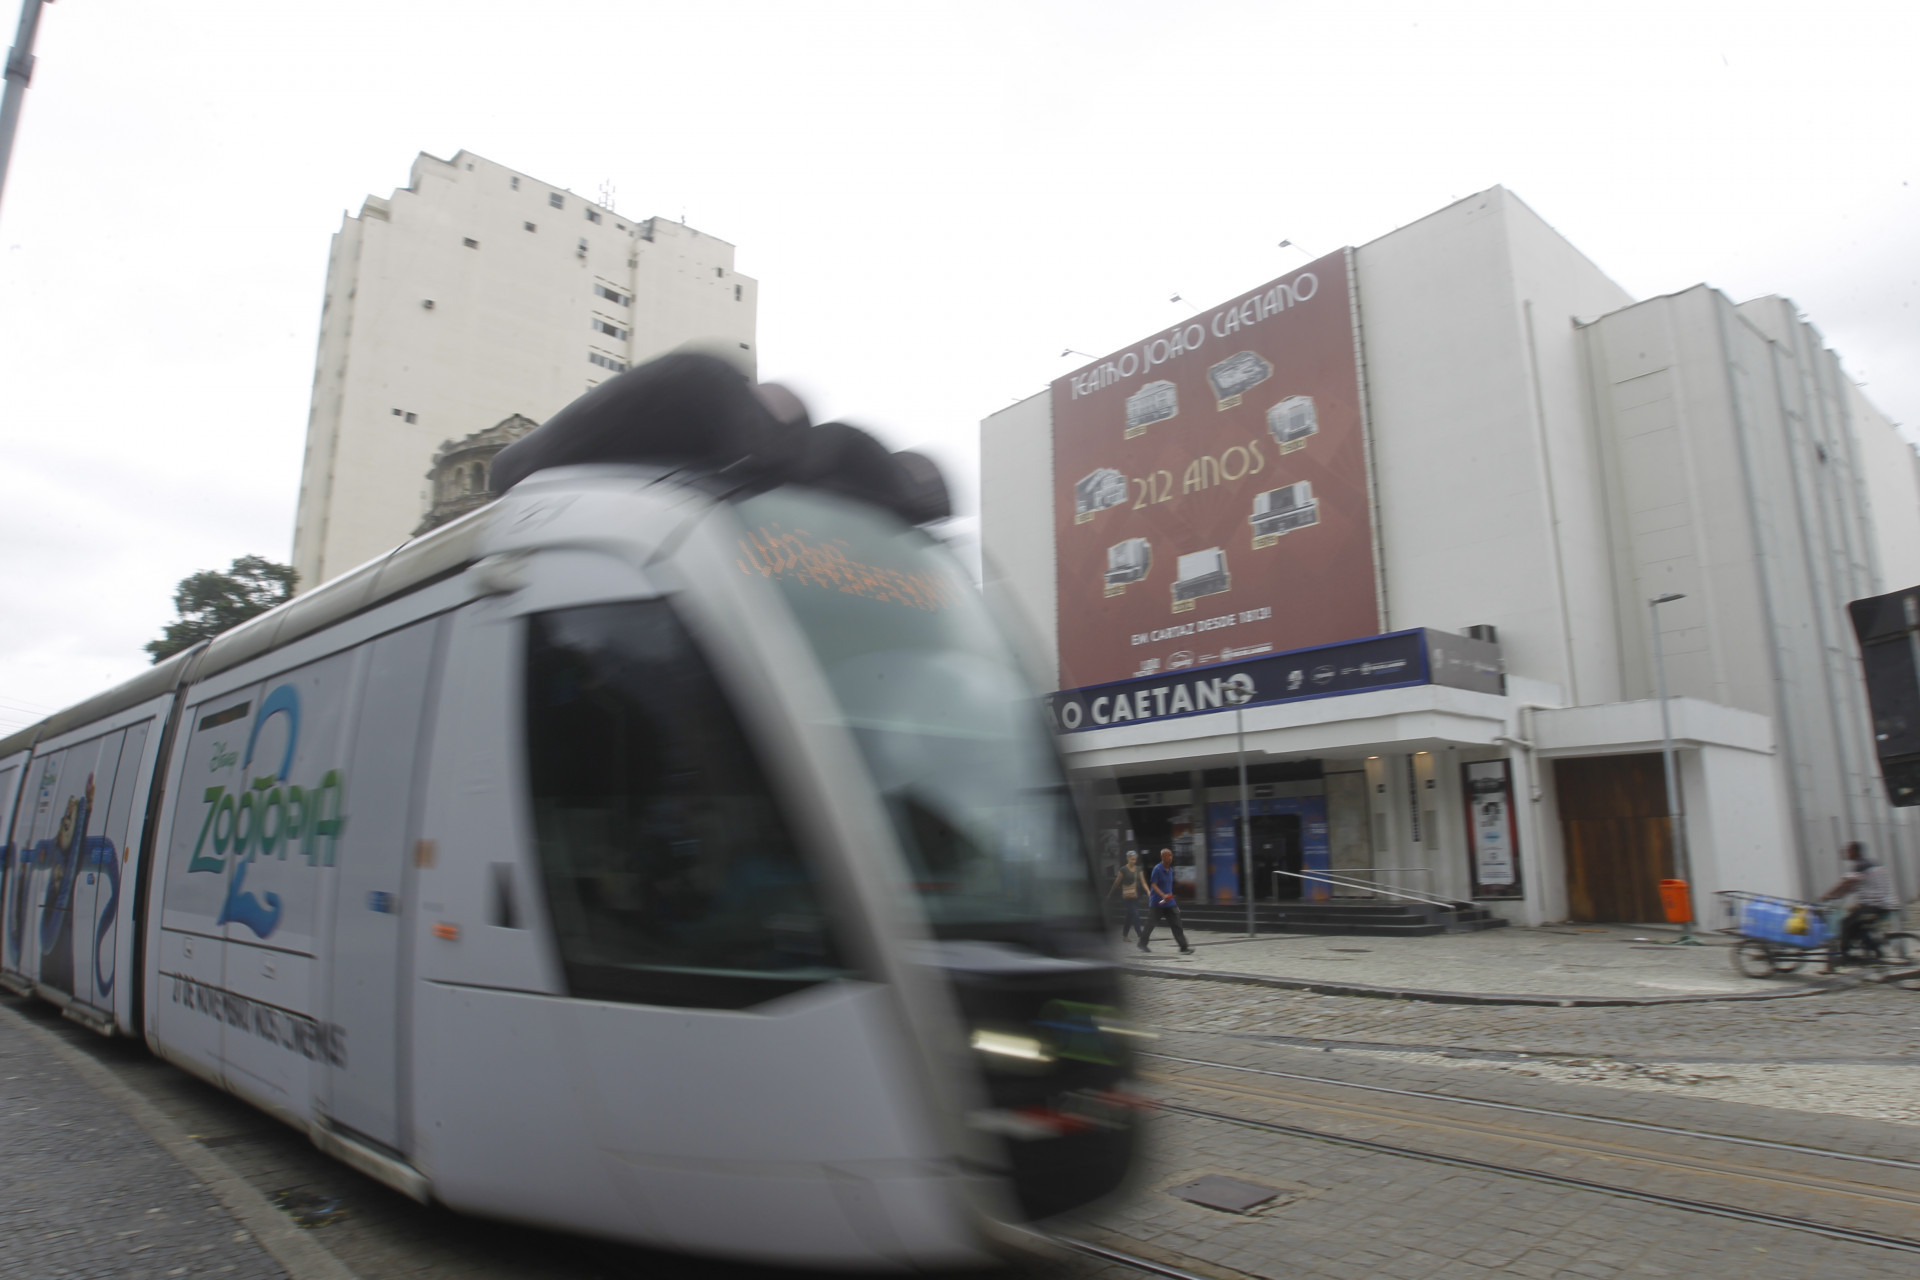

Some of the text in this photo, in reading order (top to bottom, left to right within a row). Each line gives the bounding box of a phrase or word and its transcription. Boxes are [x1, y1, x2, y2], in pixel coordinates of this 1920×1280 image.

[1069, 272, 1319, 400] TEATRO JOÃO CAETANO
[1132, 438, 1265, 511] 212 ANOS
[1131, 633, 1149, 646] EM
[1150, 622, 1195, 642] CARTAZ
[1197, 613, 1237, 632] DESDE
[1091, 672, 1255, 725] CAETANO
